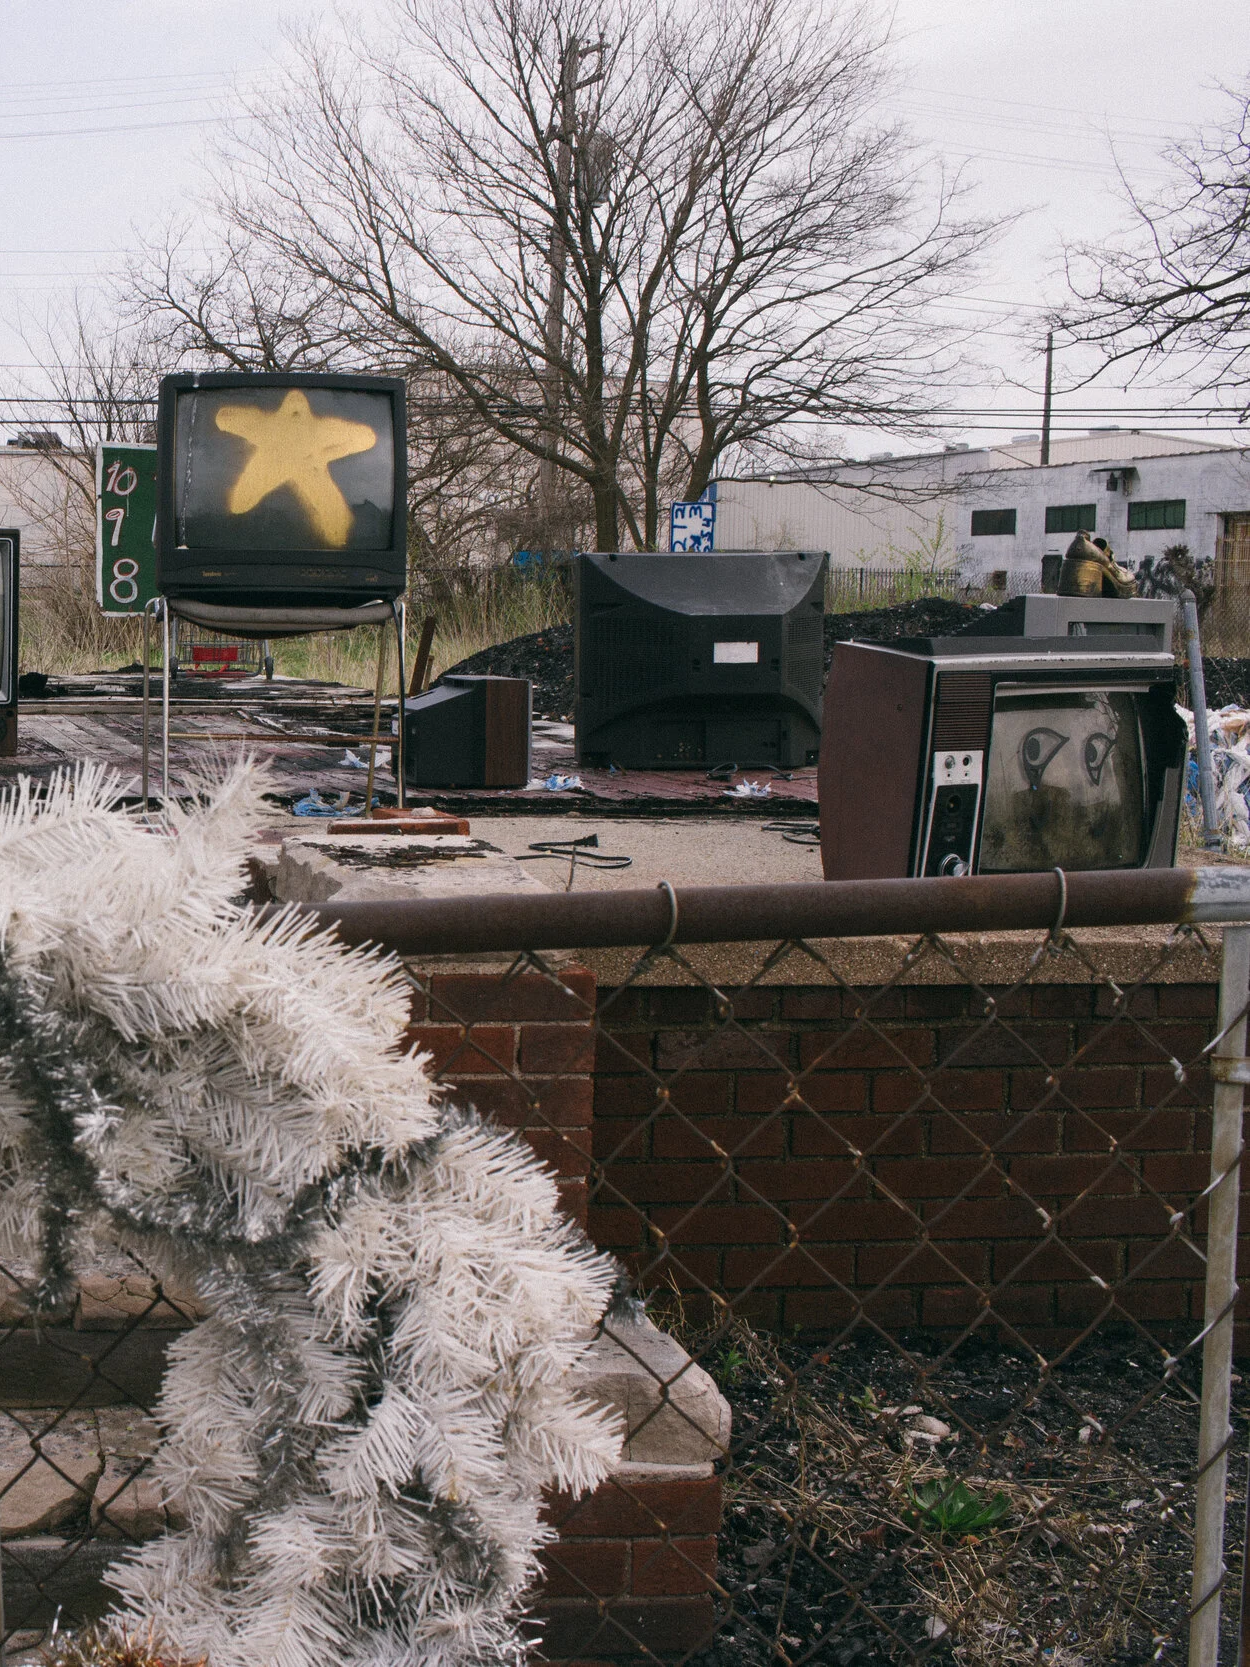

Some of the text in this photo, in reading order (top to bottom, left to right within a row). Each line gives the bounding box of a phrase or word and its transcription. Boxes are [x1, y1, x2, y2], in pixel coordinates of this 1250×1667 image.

[106, 460, 138, 496] 10
[104, 508, 125, 547] 9
[109, 558, 140, 604] 8
